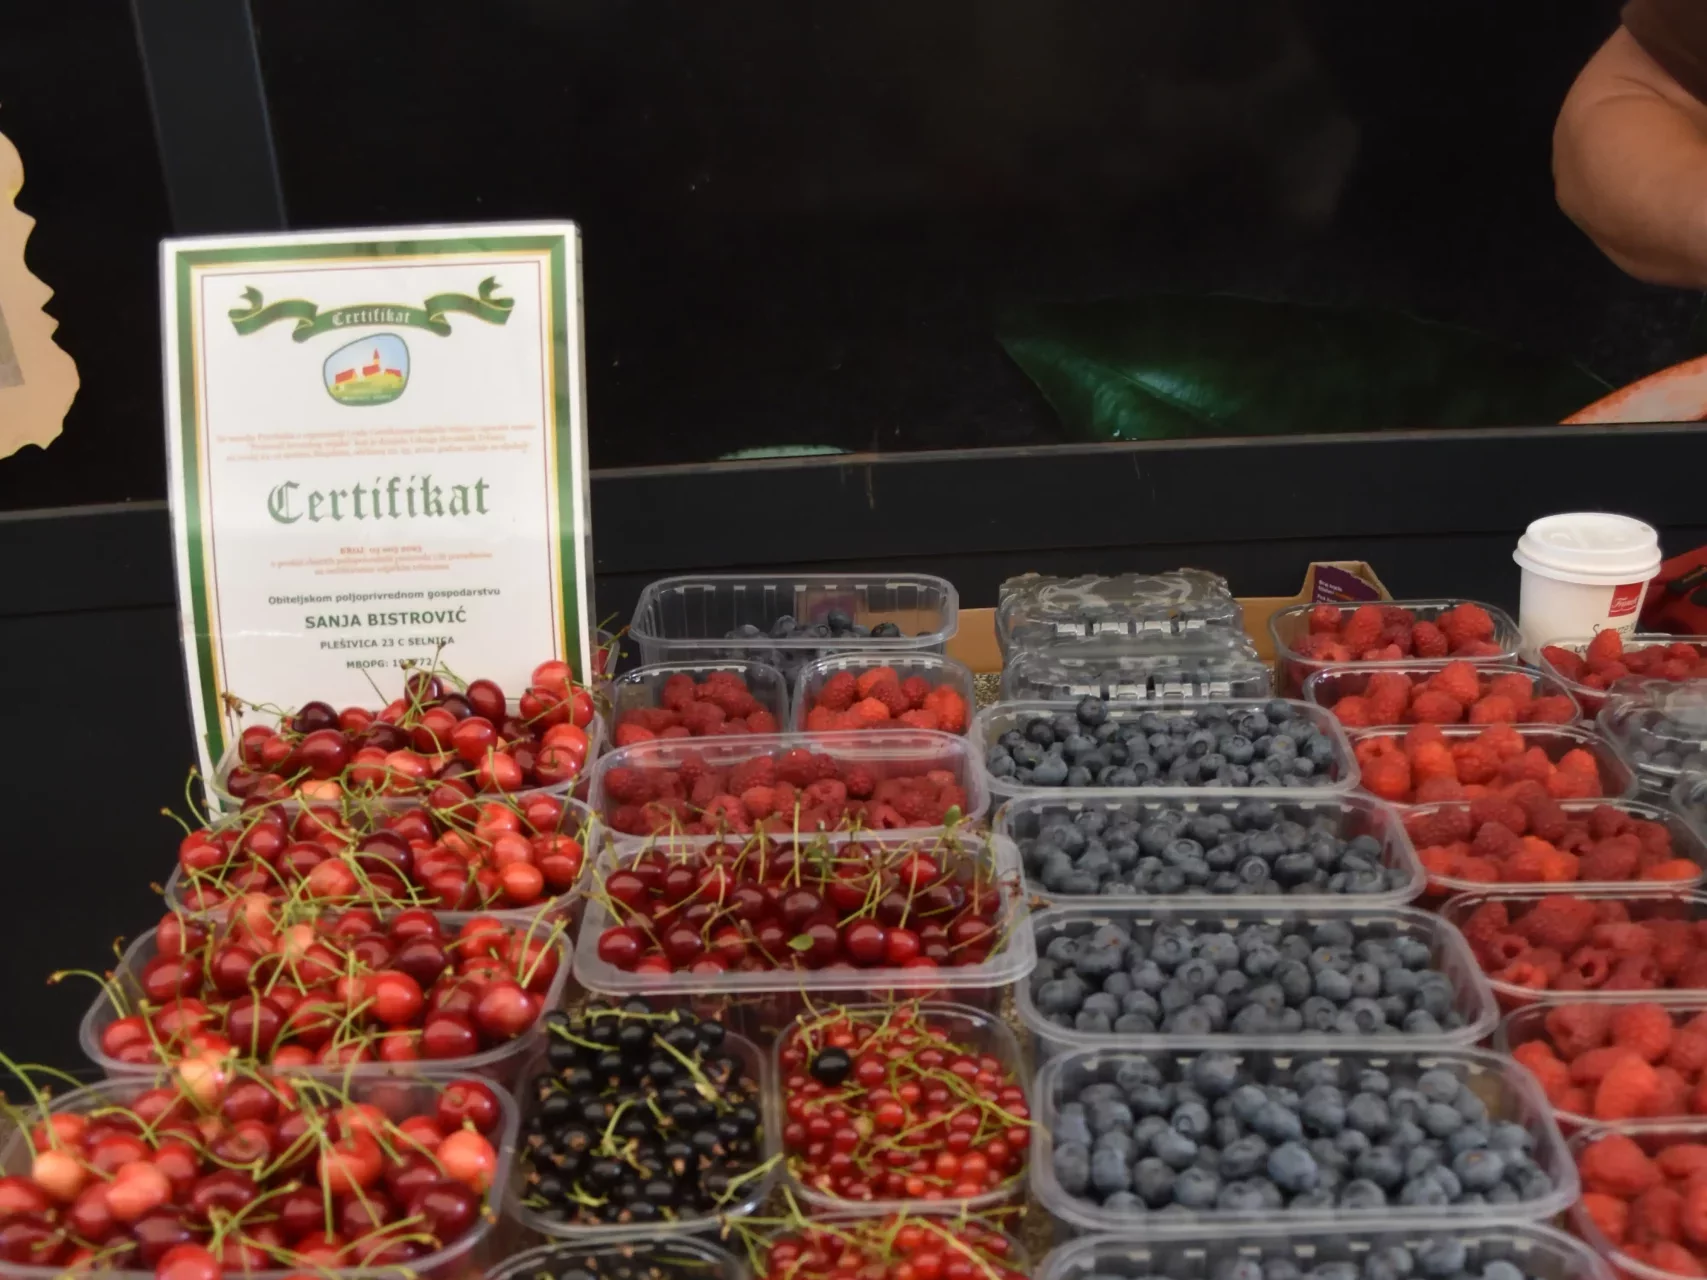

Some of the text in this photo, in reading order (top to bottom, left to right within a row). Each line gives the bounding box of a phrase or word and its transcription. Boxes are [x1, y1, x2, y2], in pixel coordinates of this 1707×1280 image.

[332, 308, 411, 326] Certifikat
[267, 474, 490, 524] Certifikat
[268, 586, 501, 605] Obiteljskom poljoprivrednom gospodarstvu
[305, 605, 467, 629] SANJA BISTROVIĆ
[320, 639, 378, 650] PLEŠIVICA
[382, 639, 394, 648] 23
[346, 659, 389, 669] MBOPG:
